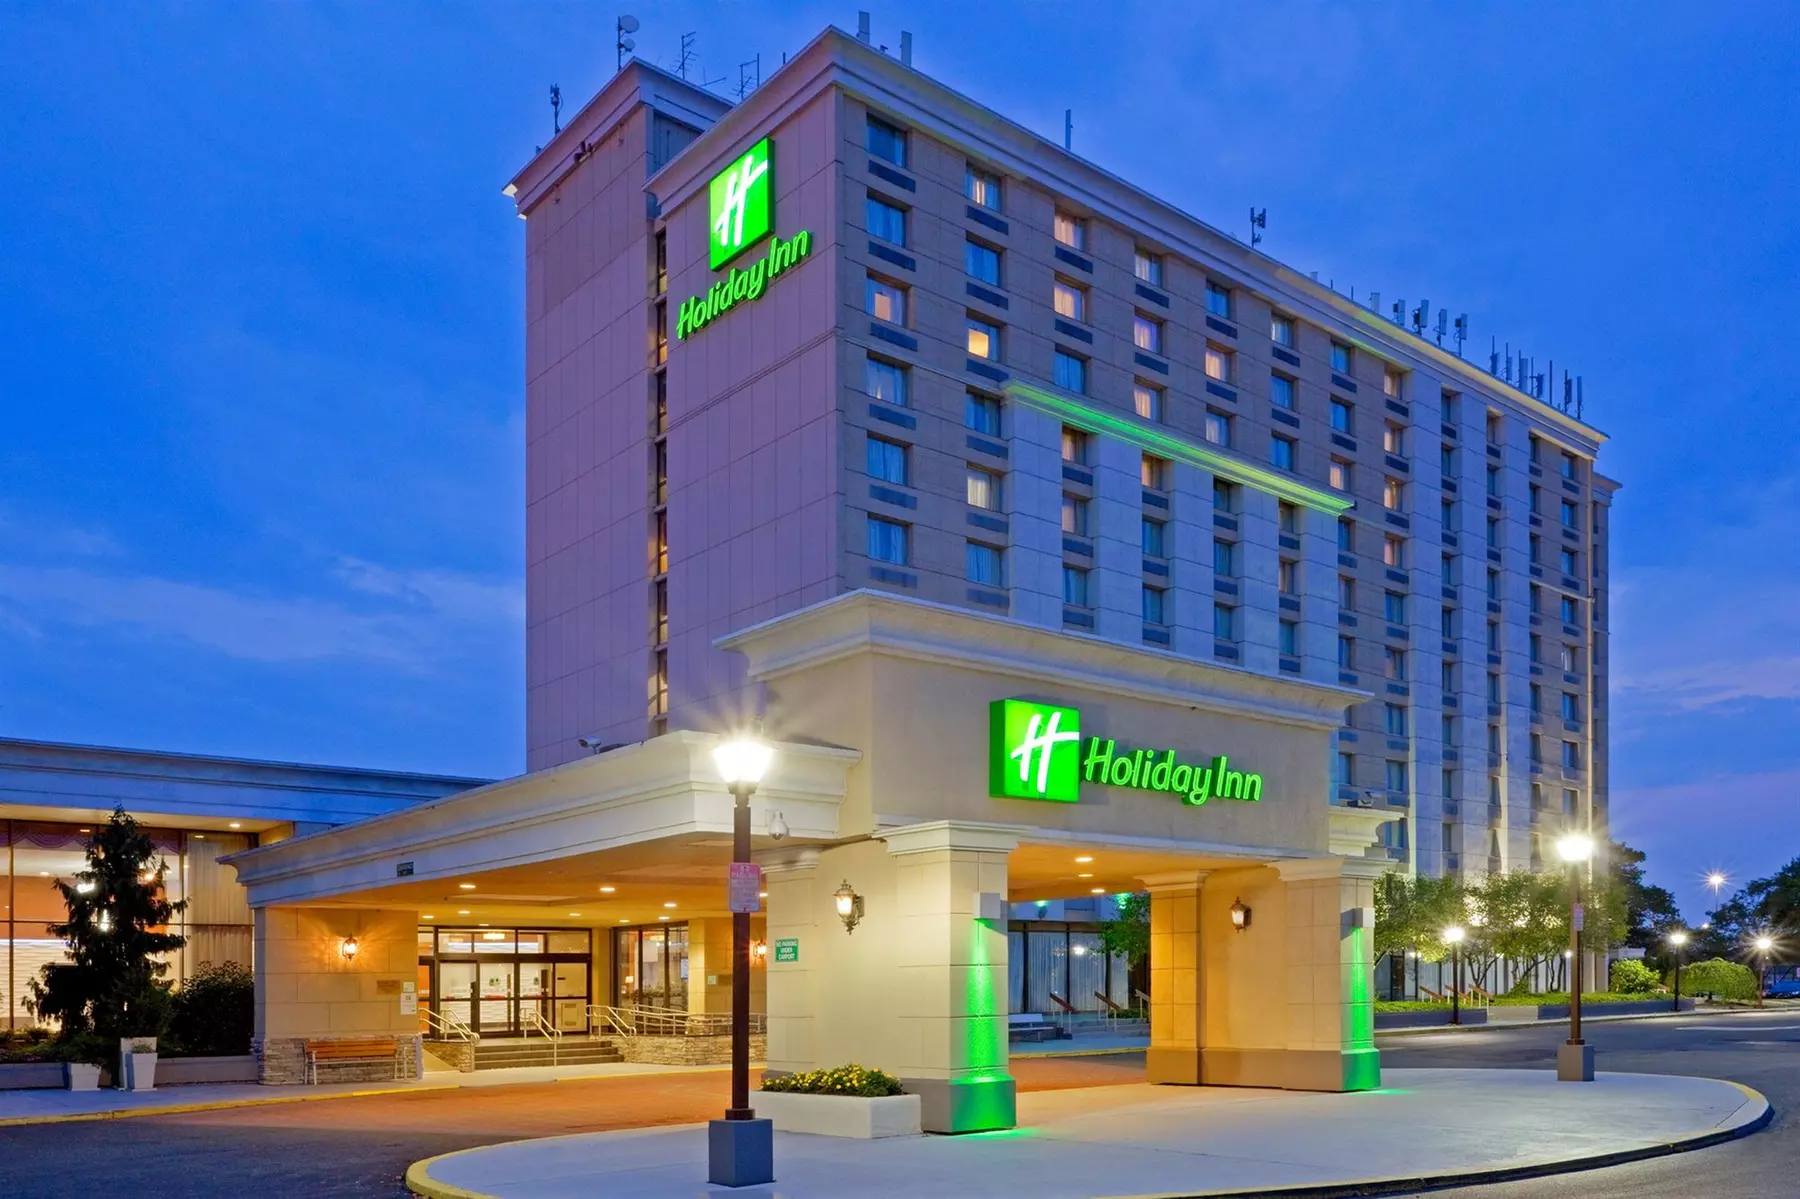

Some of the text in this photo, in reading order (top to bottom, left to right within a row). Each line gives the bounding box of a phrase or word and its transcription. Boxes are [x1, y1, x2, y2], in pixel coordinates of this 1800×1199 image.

[676, 229, 812, 339] Holiday Inn
[1084, 736, 1263, 805] Holiday Inn
